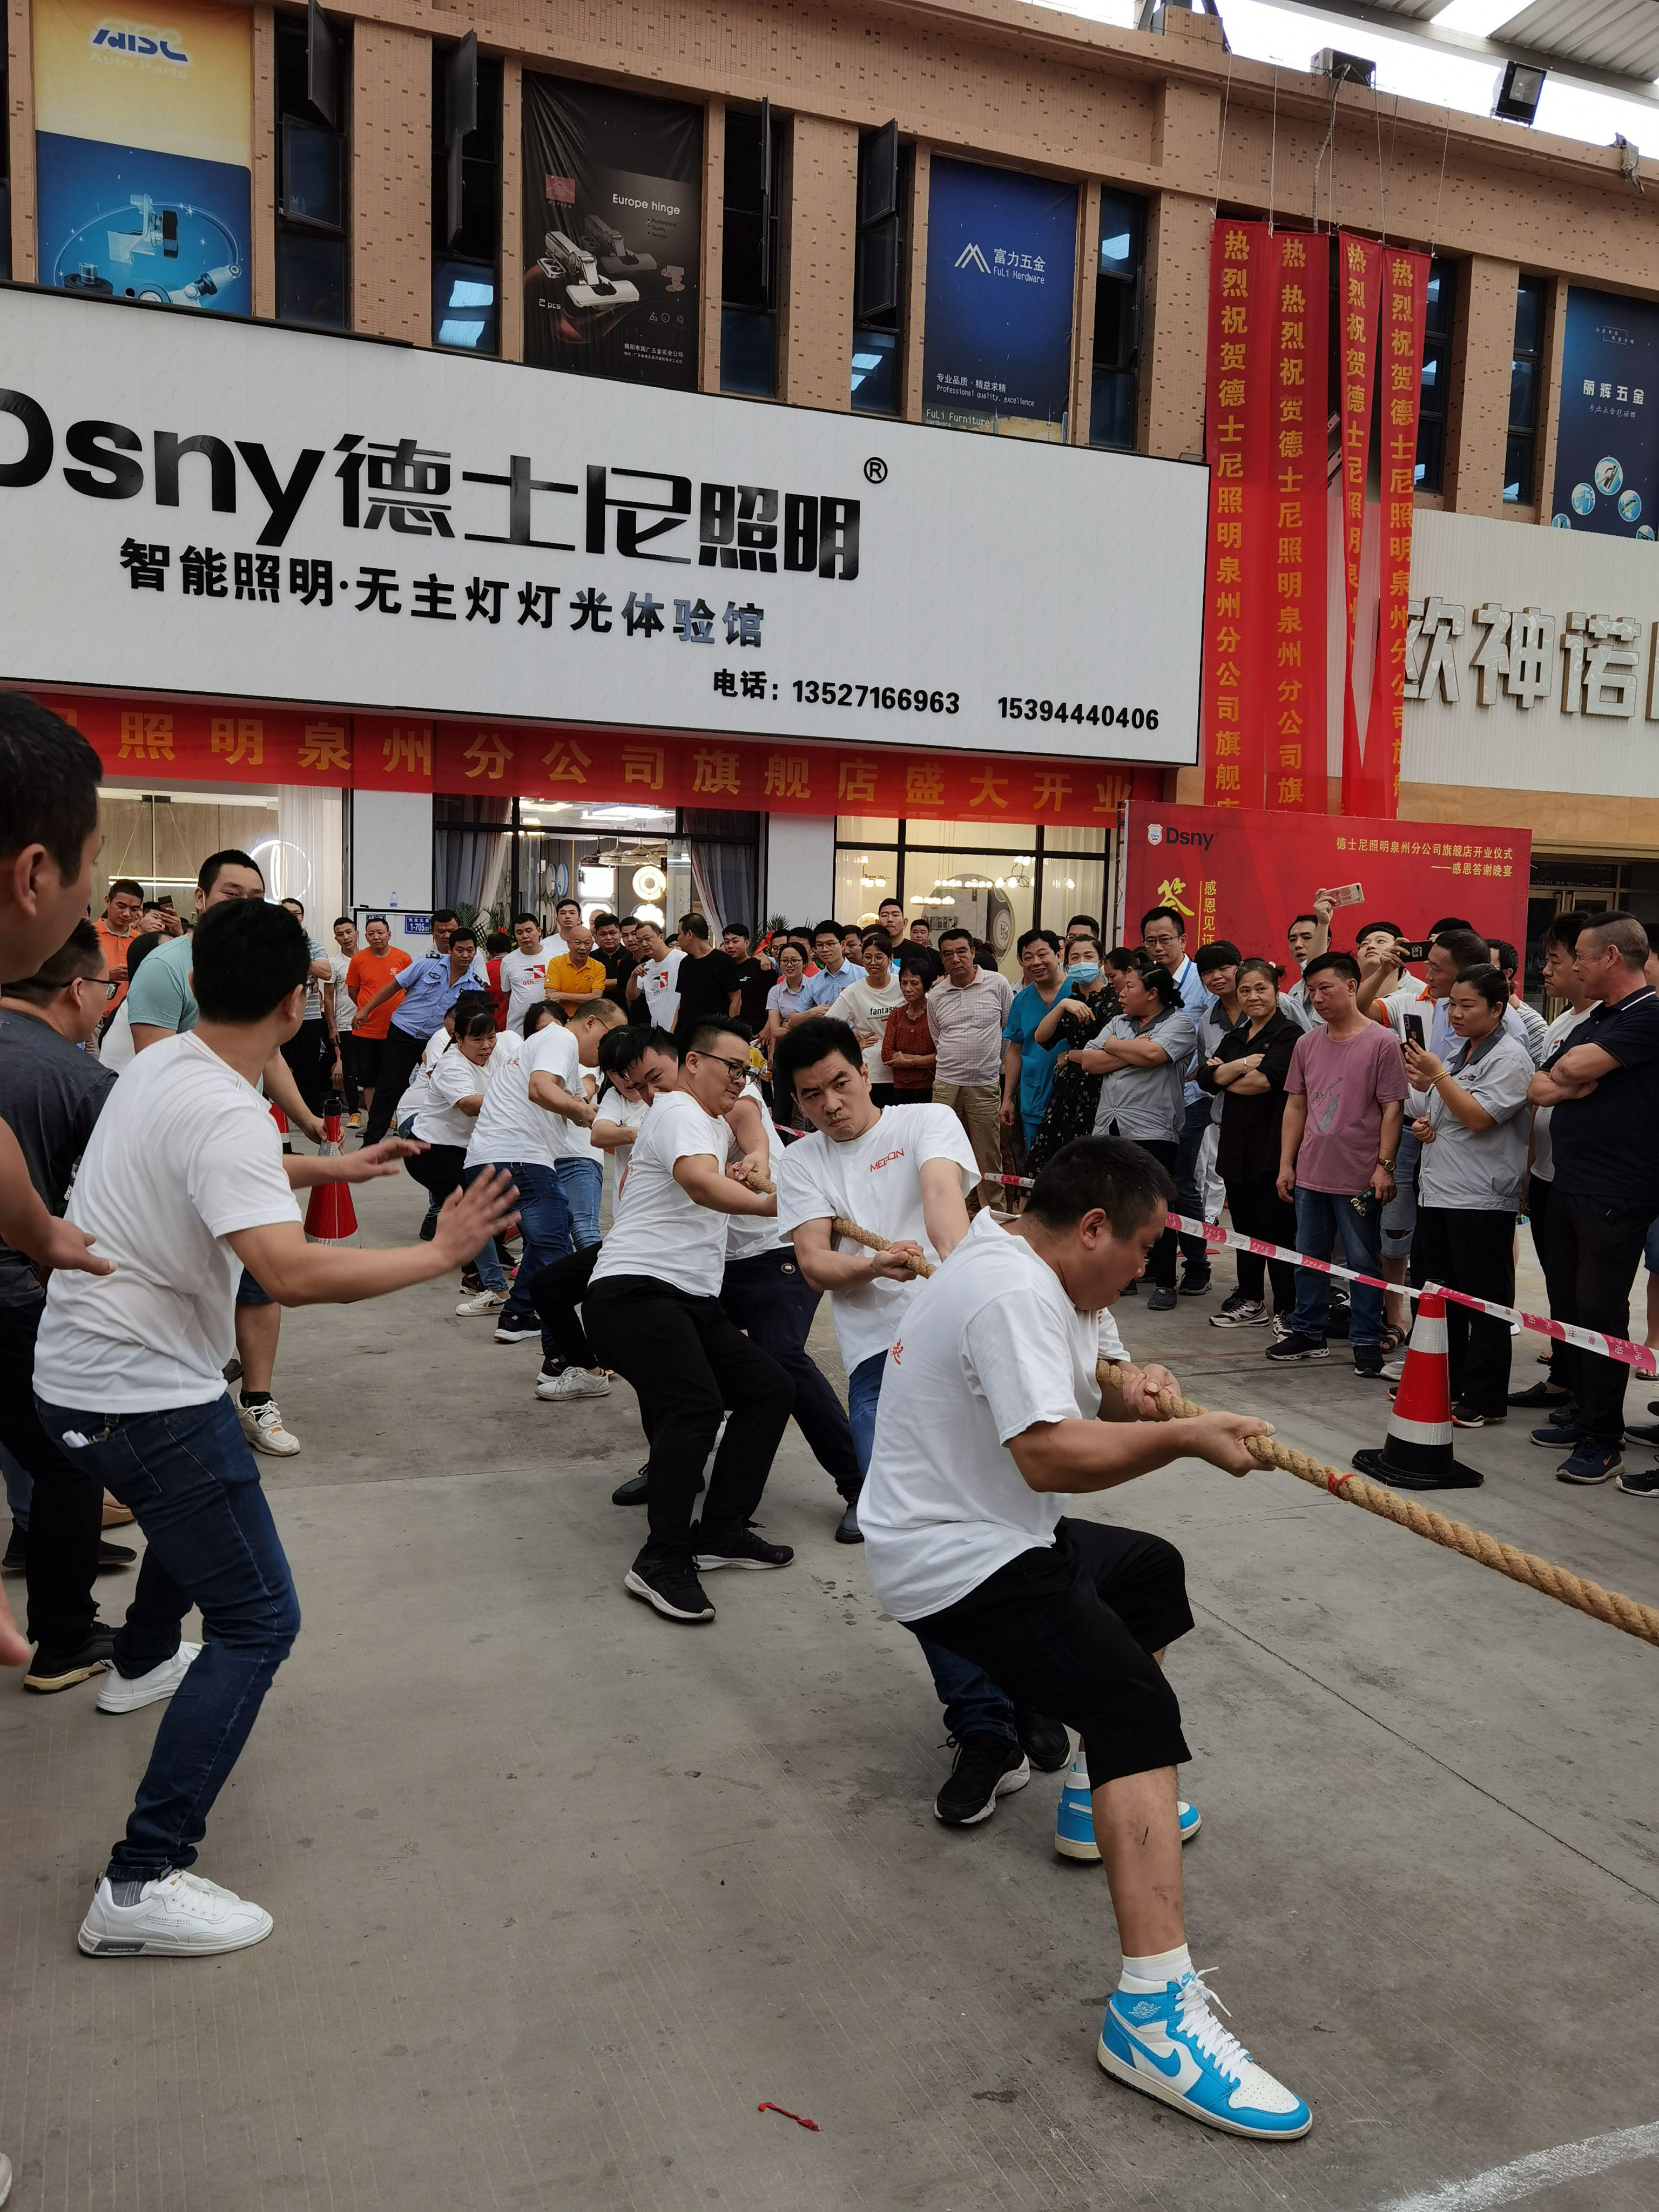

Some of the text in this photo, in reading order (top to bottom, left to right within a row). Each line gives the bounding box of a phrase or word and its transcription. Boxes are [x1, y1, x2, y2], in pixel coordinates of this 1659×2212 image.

[612, 193, 681, 215] Europe hinge
[994, 248, 1046, 273] 富力五金
[993, 266, 1045, 284] FuLi Hardware
[538, 298, 562, 310] 2 pcs
[936, 384, 974, 397] Professional
[1003, 396, 1035, 407] excellence
[1583, 379, 1644, 405] 丽辉五金
[926, 409, 990, 427] FuLi Furniture
[333, 433, 861, 581] 德士尼照明
[120, 537, 765, 648] 智能照明·无主灯灯光体验馆
[1404, 596, 1659, 720] 欧神诺
[792, 680, 961, 714] 13527166963
[997, 696, 1159, 730] 15394440406
[54, 708, 1132, 813] 照明泉州分公司旗舰店盛大开业
[1166, 827, 1215, 852] Dsny
[1336, 837, 1513, 860] 德士尼照明泉州分公司旗舰店开业仪式
[1202, 880, 1217, 946] 感恩见证
